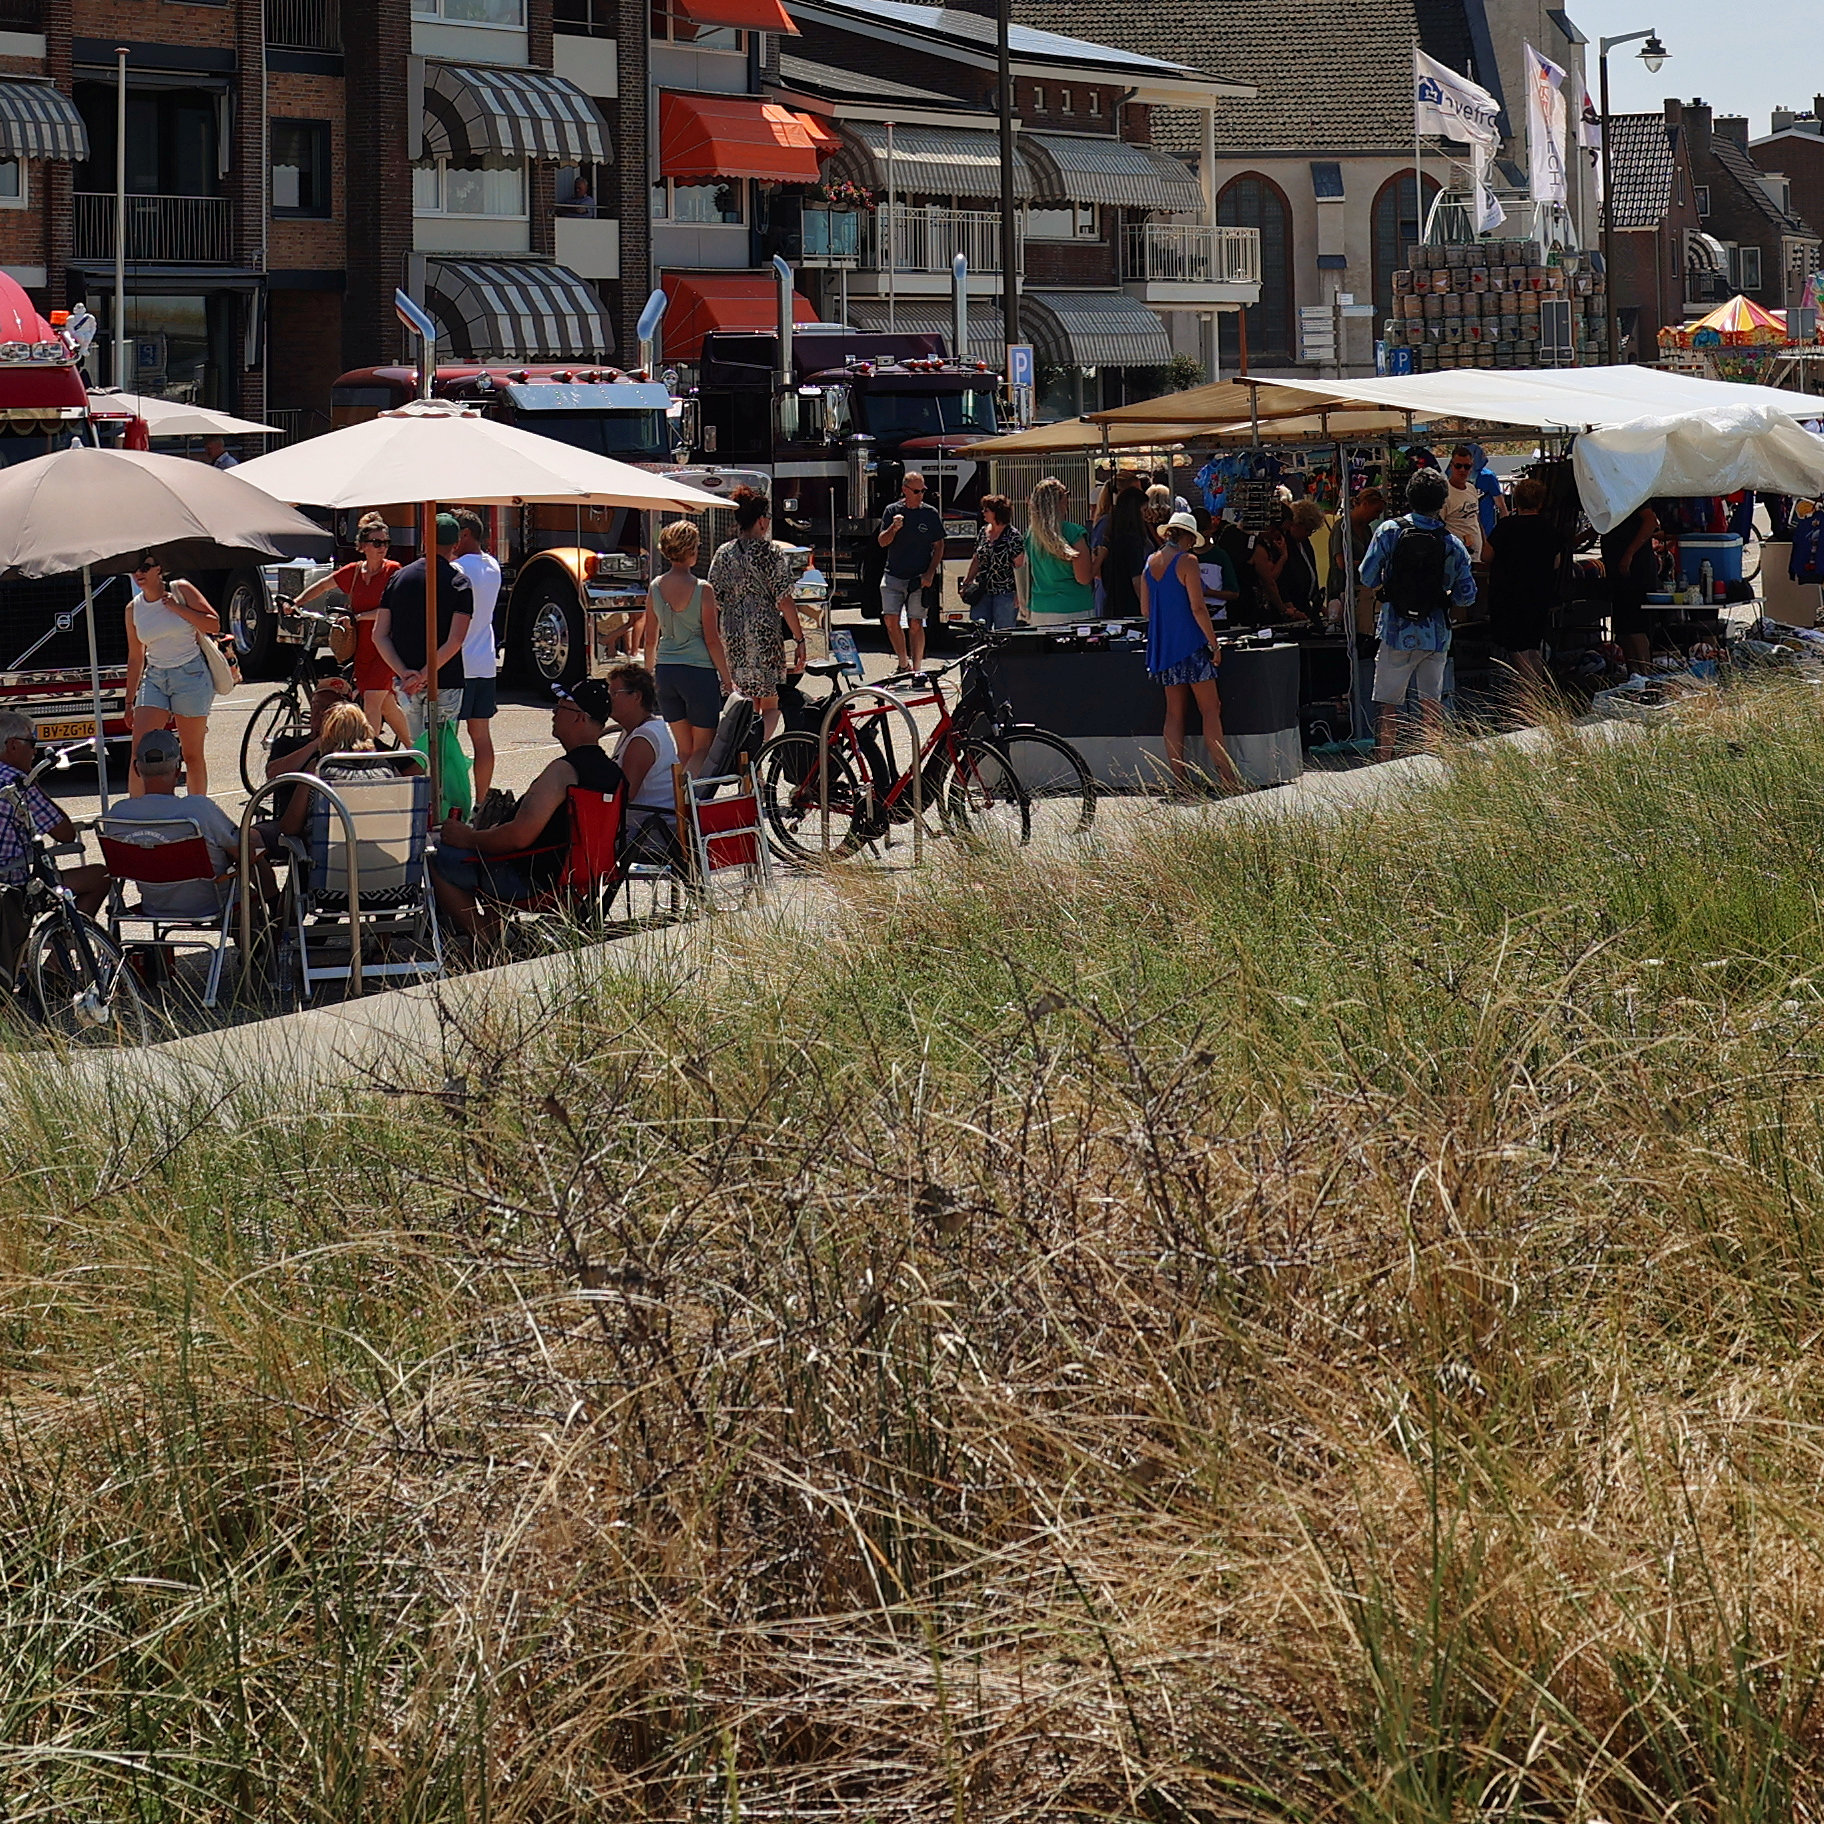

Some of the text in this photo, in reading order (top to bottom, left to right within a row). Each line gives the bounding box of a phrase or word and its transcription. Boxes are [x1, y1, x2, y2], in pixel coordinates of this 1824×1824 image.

[1016, 352, 1028, 384] P
[1399, 352, 1408, 368] P
[42, 724, 96, 739] BV-ZG-16
